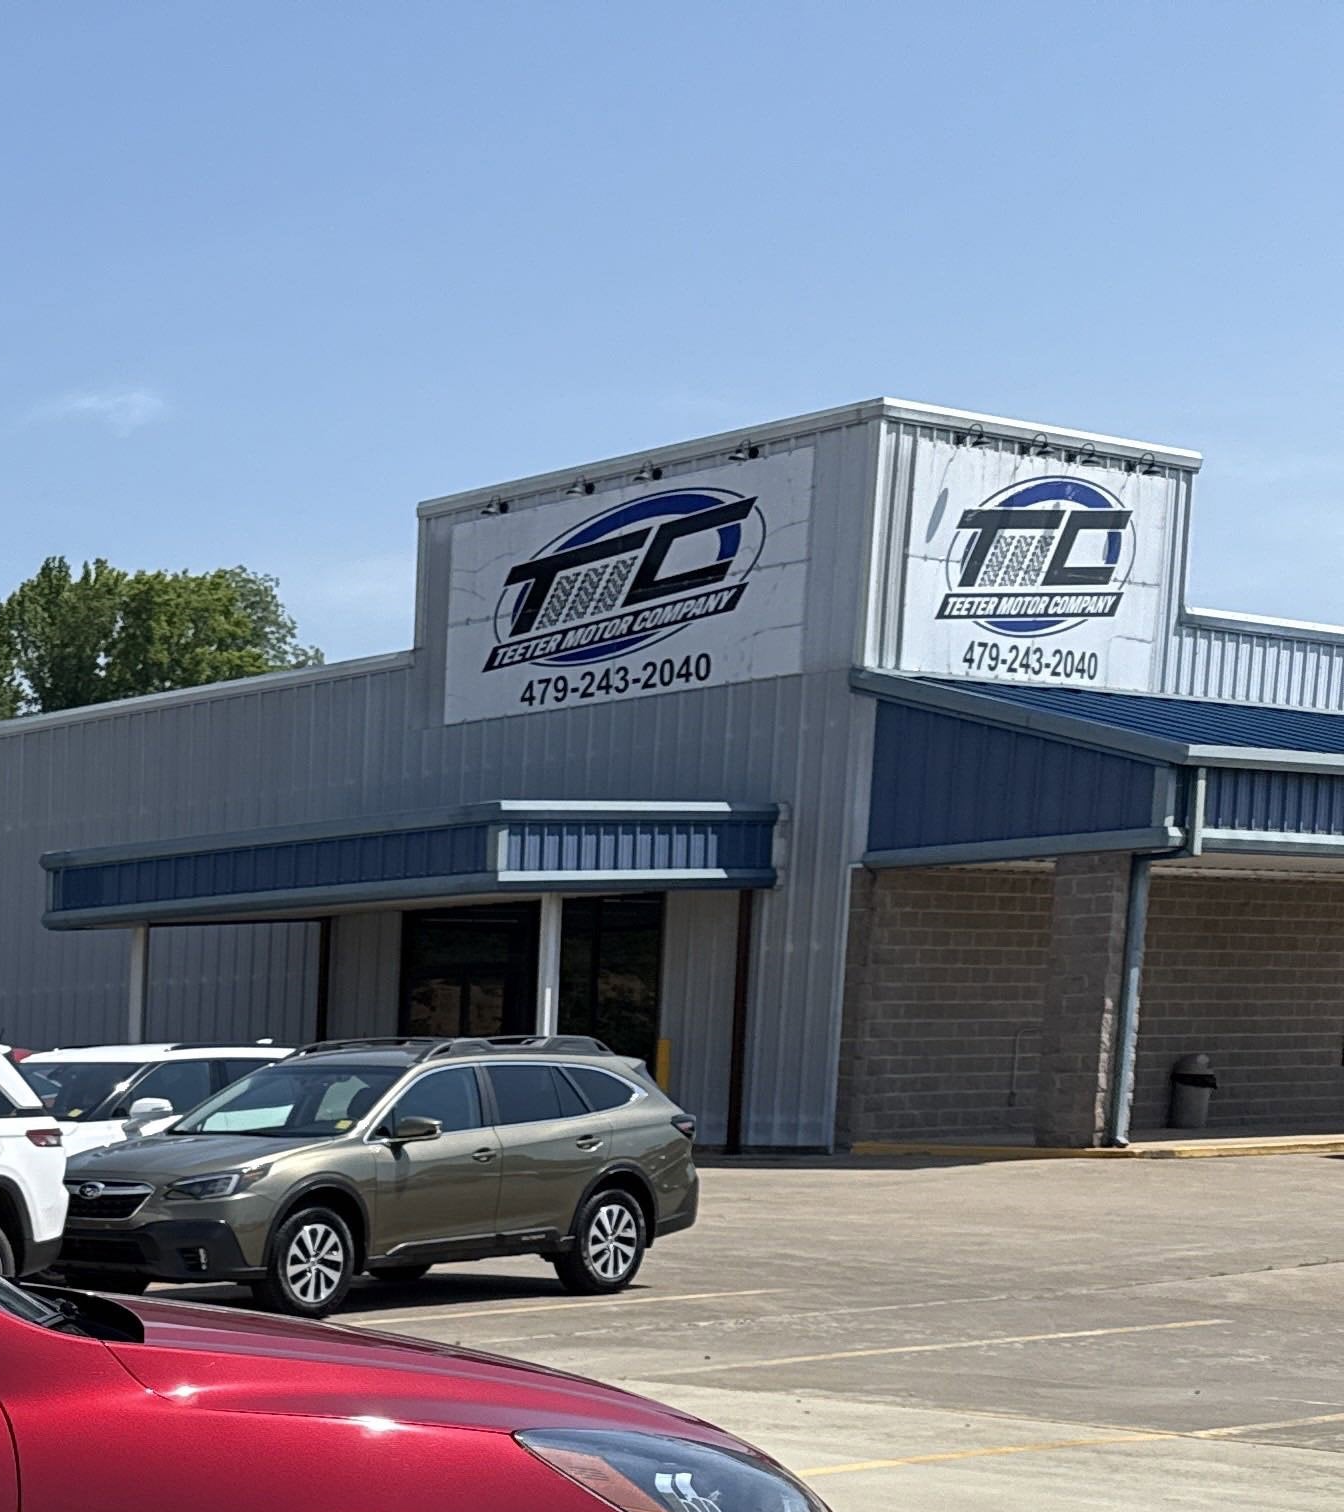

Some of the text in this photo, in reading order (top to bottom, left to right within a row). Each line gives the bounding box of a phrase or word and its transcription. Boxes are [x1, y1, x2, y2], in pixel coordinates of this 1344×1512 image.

[495, 589, 735, 666] TEETER MOTOR COMPANY
[944, 595, 1117, 616] TEETER MOTOR COMPANY
[520, 653, 712, 706] 479-243-2040
[962, 640, 1098, 680] 479-243-2040
